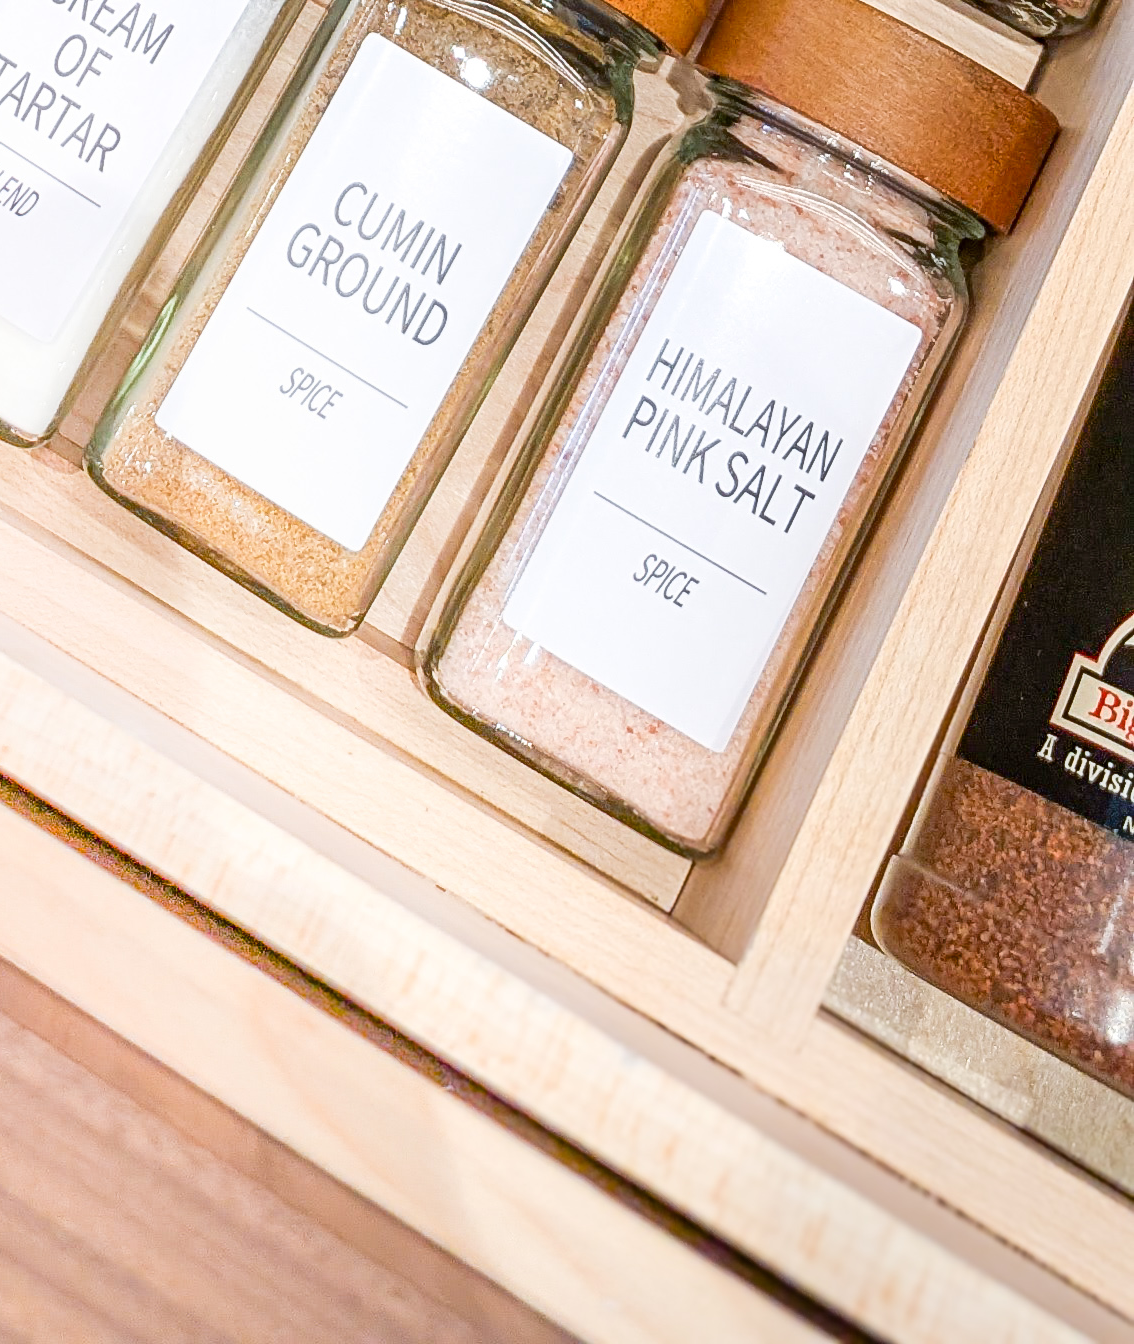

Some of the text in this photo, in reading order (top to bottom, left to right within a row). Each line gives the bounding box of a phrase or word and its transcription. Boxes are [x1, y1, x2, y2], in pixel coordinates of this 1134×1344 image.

[55, 34, 112, 88] OF
[334, 181, 462, 285] CUMIN
[287, 223, 449, 346] GROUND
[280, 367, 344, 419] SPICE
[646, 339, 843, 481] HIMALAYAN
[623, 395, 815, 534] PINK SALT
[634, 554, 700, 608] SPICE
[1037, 734, 1058, 761] A
